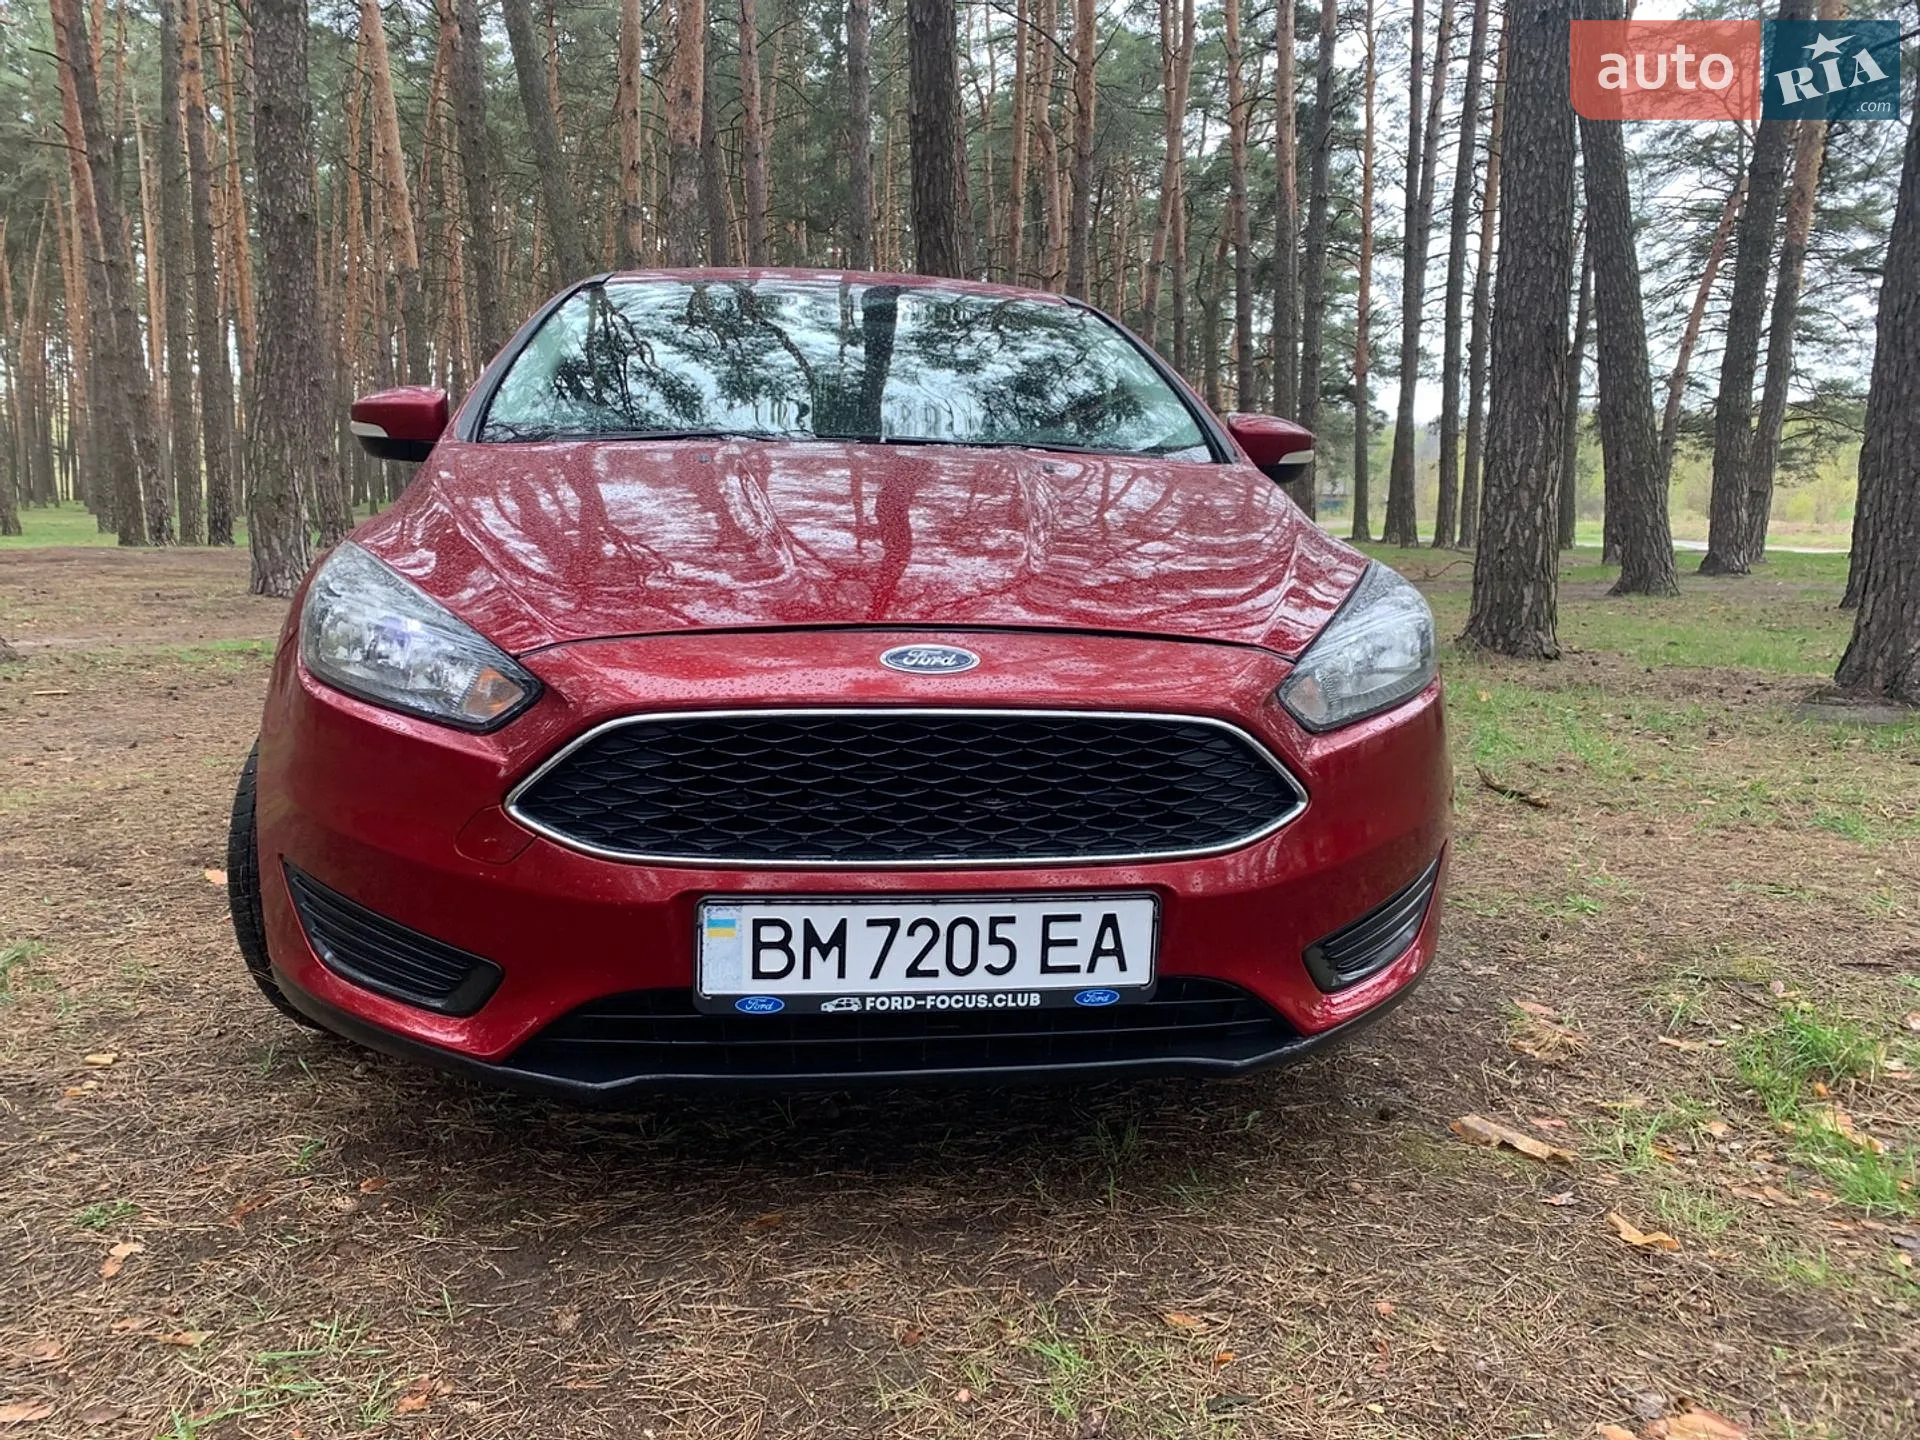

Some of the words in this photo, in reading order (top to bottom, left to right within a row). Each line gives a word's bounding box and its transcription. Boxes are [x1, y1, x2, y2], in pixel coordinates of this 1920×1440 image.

[902, 649, 958, 666] Ford
[751, 917, 848, 980] BM
[865, 914, 1018, 978] 7205
[1039, 912, 1128, 975] EA
[865, 992, 1041, 1011] FORD-FOCUS.CLUB
